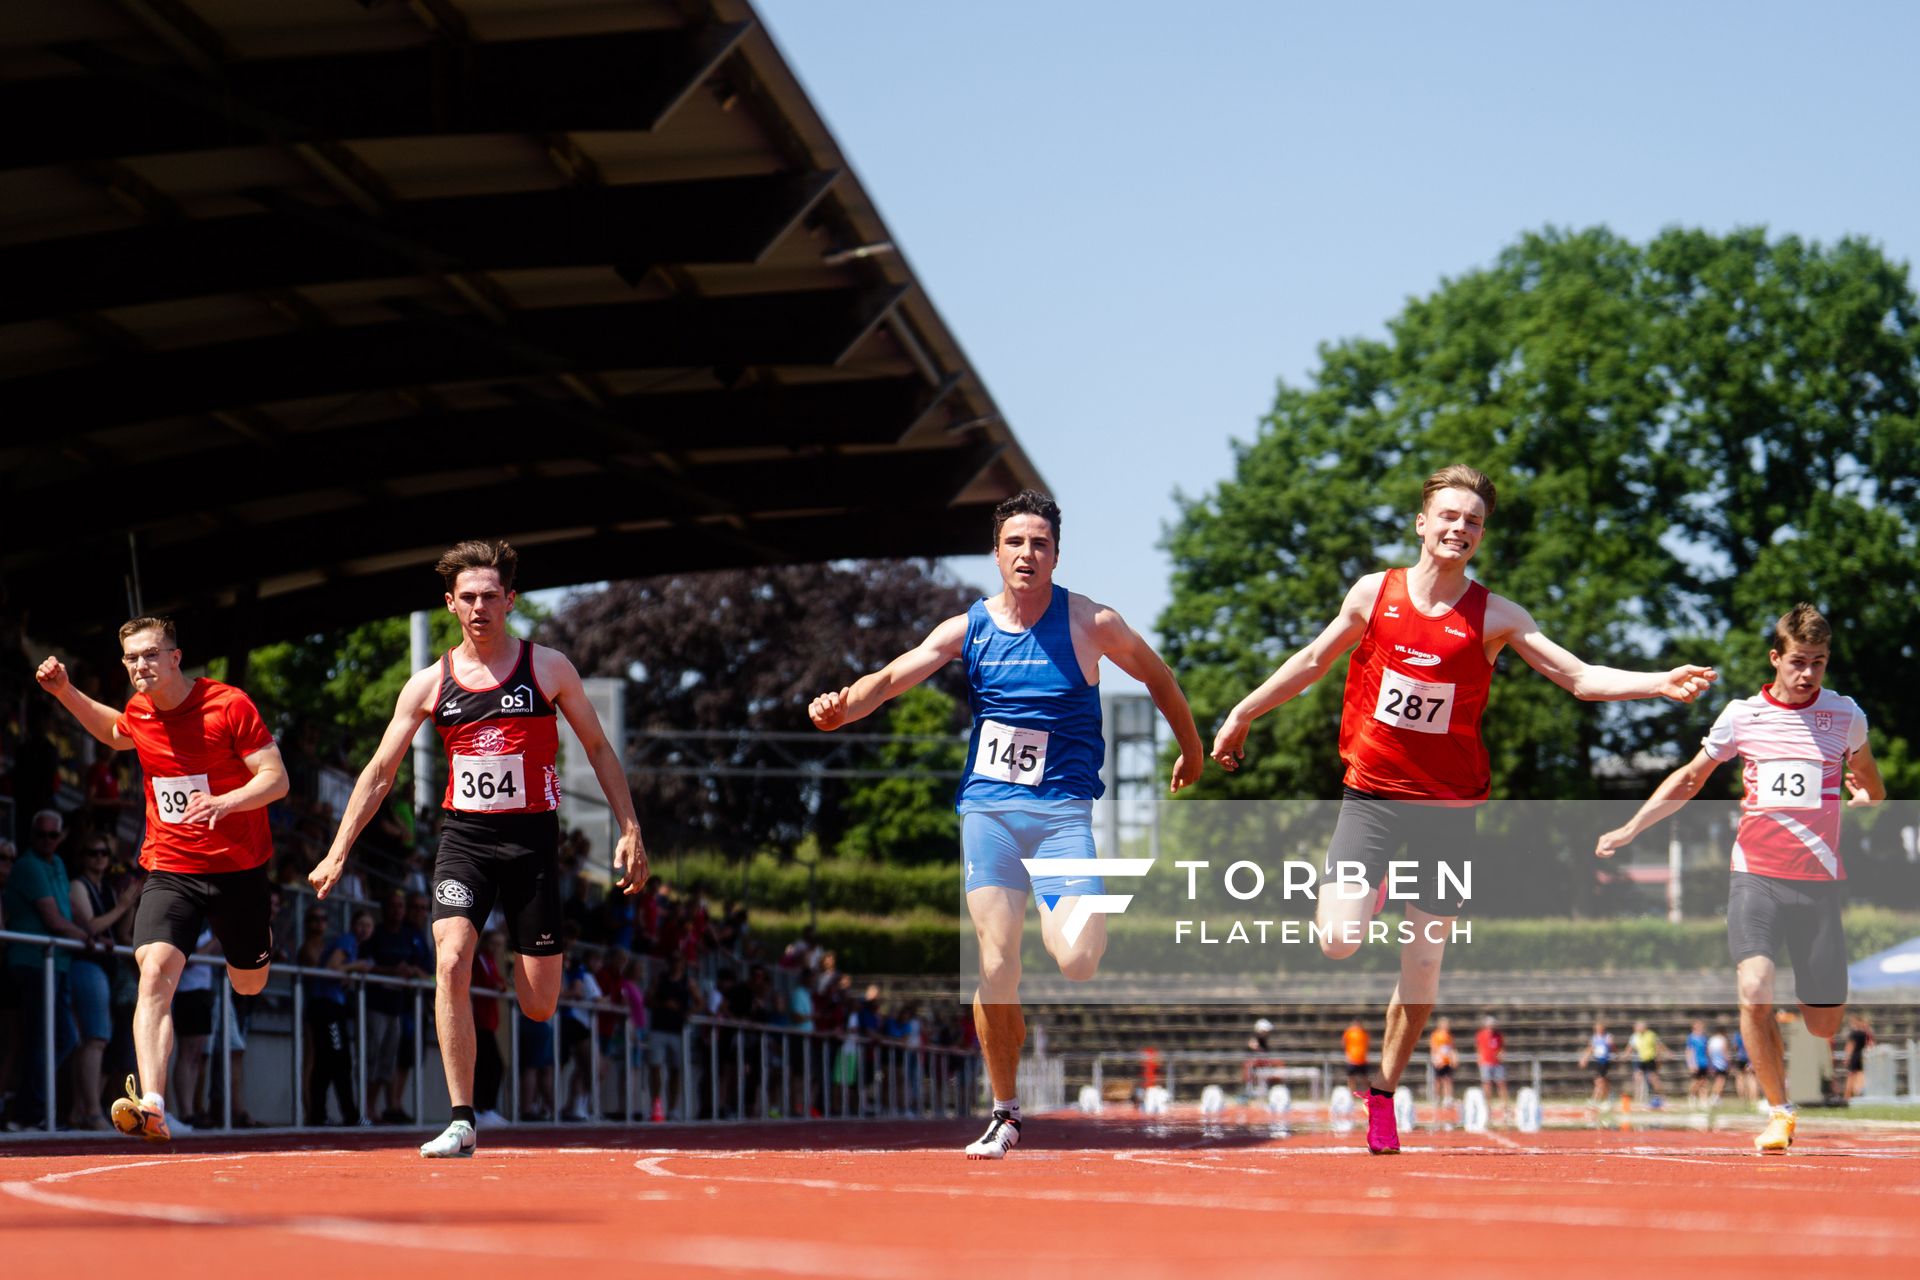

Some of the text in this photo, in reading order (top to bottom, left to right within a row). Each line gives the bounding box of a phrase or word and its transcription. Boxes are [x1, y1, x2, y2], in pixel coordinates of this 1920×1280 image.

[1444, 626, 1466, 638] Torben
[1407, 648, 1431, 659] Lingen
[501, 694, 524, 708] OS
[1384, 688, 1445, 723] 287
[988, 738, 1038, 772] 145
[461, 771, 516, 799] 364
[1771, 773, 1805, 797] 43
[161, 789, 201, 814] 39
